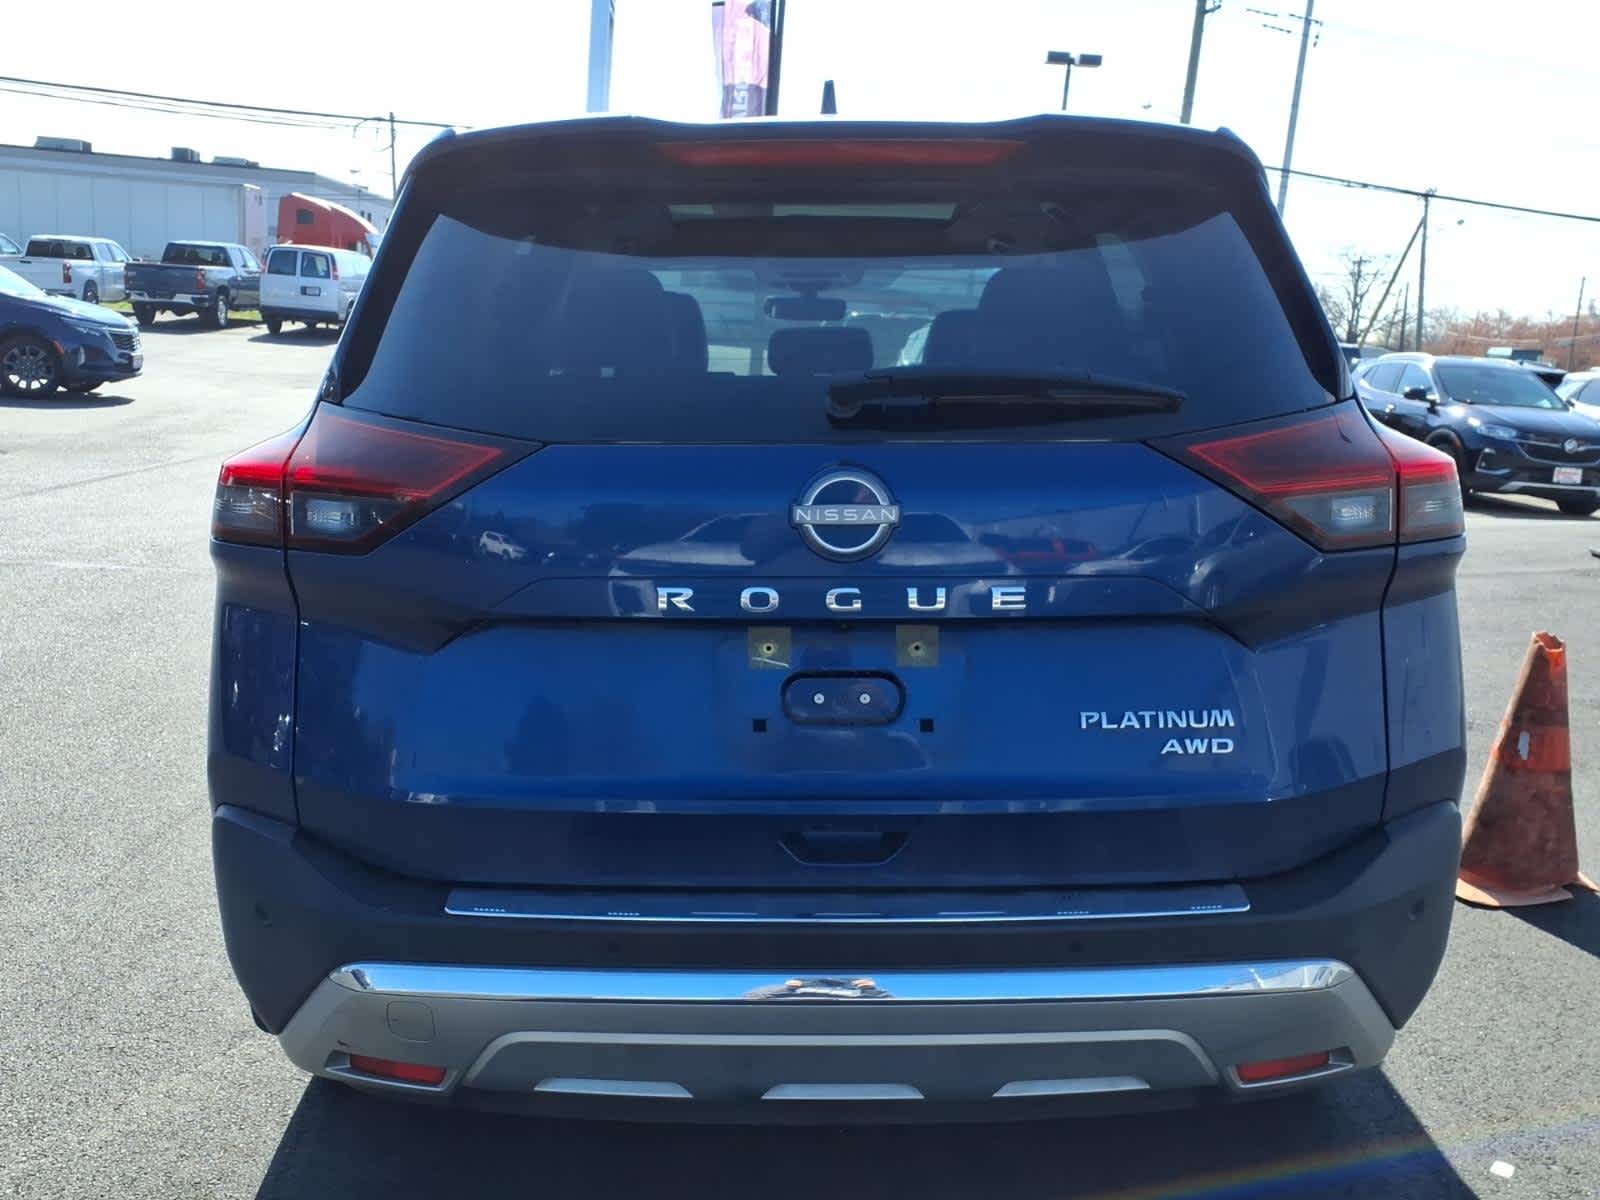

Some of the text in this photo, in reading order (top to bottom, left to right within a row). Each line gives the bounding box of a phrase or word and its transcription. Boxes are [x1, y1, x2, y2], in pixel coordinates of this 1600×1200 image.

[796, 508, 897, 521] NISSAN
[656, 587, 1026, 613] ROGUE
[1080, 709, 1235, 729] PLATINUM
[1160, 738, 1235, 755] AWD
